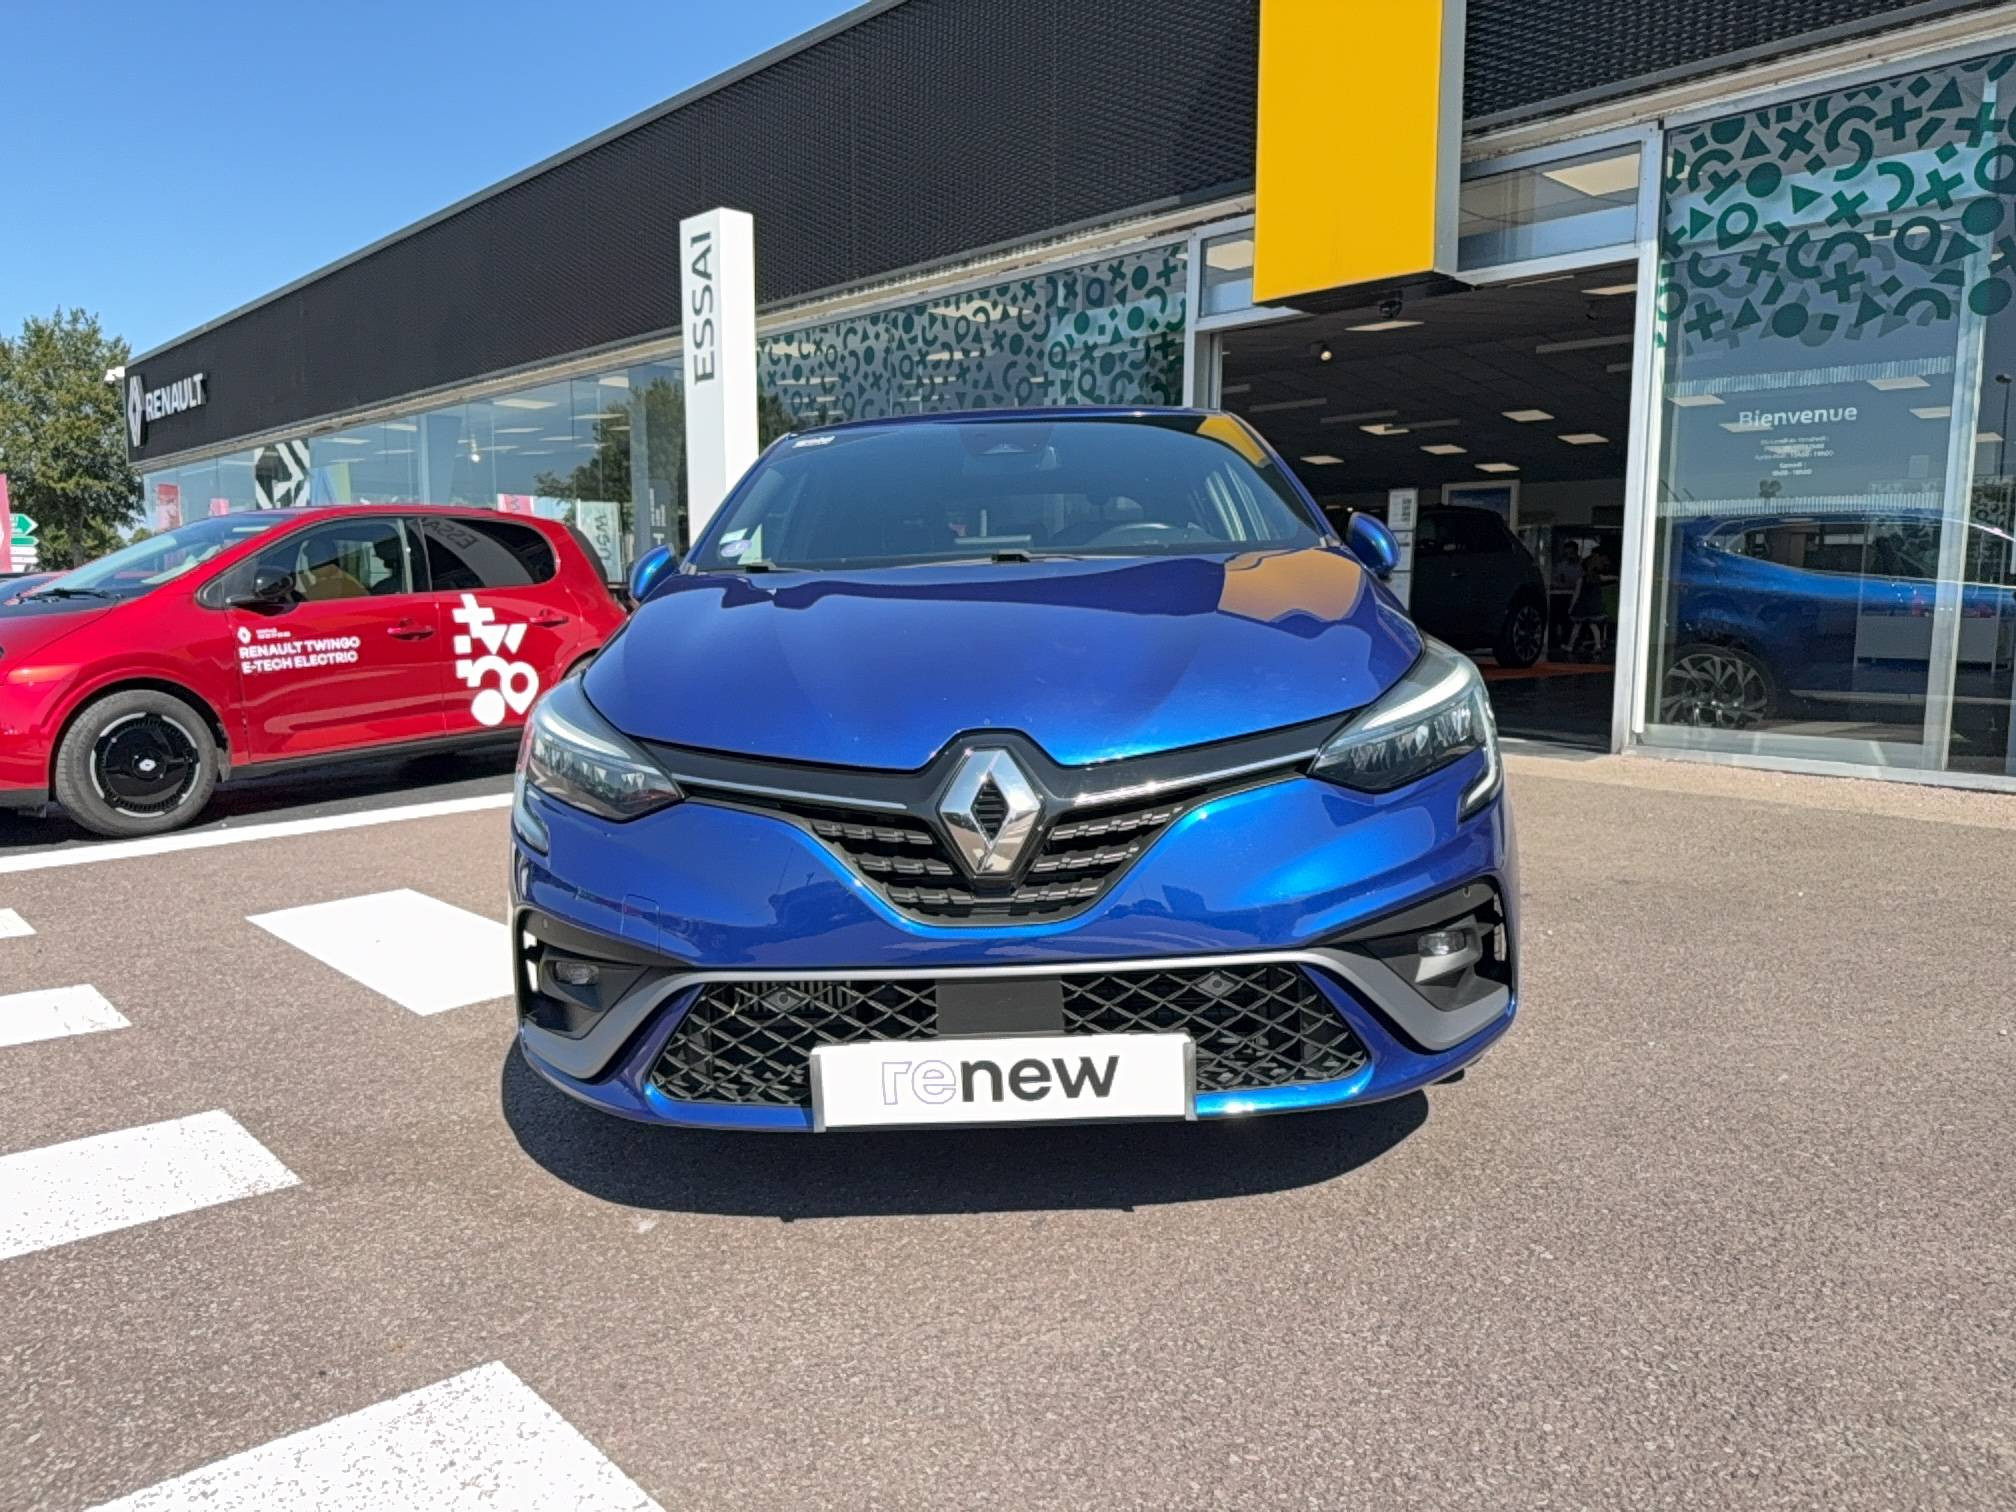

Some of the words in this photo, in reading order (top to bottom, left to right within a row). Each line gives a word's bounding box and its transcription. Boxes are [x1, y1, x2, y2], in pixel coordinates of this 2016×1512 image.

[690, 231, 715, 384] ESSAI
[145, 373, 203, 422] RENAULT
[1738, 406, 1858, 427] Bienvenue
[239, 640, 303, 659] RENAULT
[304, 636, 361, 652] TWINGO
[241, 657, 293, 674] E-TECH
[294, 650, 359, 668] ELECTRIC
[881, 1055, 1120, 1105] renew
